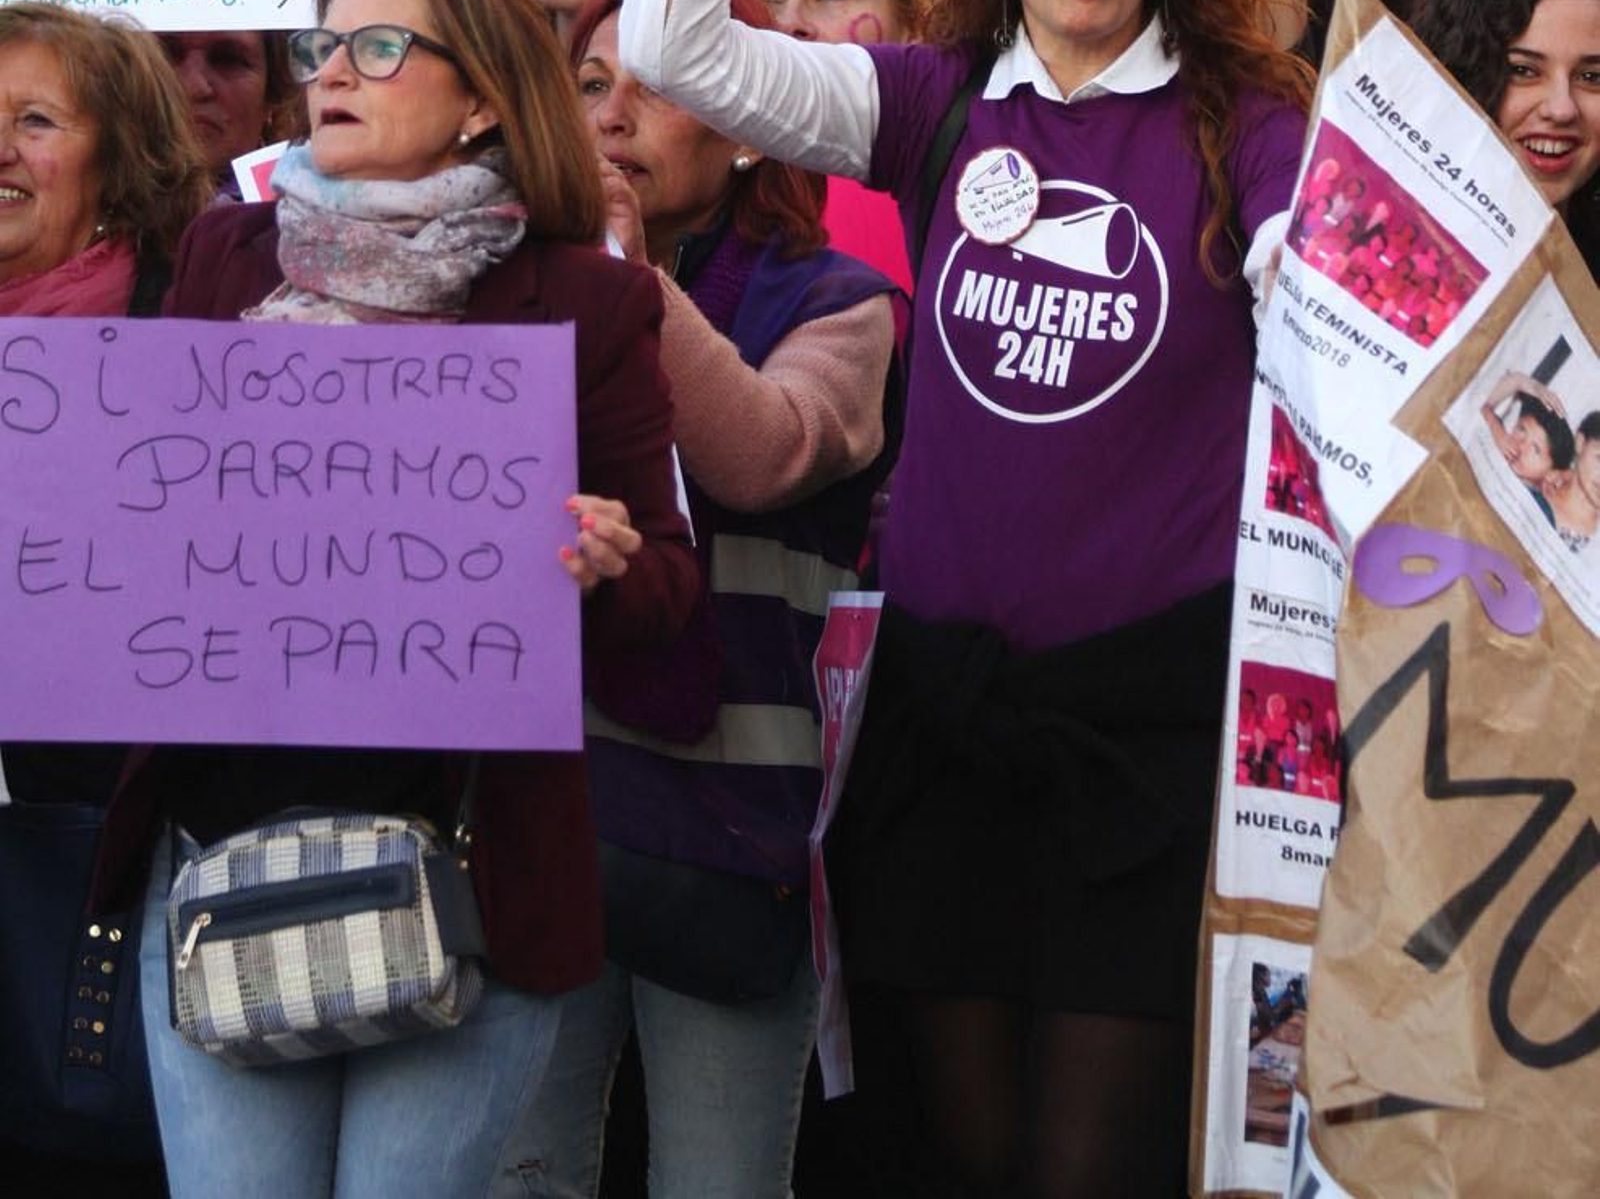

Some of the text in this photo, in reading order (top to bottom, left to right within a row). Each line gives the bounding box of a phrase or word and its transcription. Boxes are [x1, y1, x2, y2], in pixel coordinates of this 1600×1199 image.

[1354, 73, 1433, 154] Mujeres
[1432, 151, 1463, 182] 24
[1462, 176, 1518, 241] horas
[952, 268, 1139, 342] MUJERES
[1303, 296, 1409, 377] FEMINISTA
[994, 330, 1075, 388] 24H
[116, 434, 542, 512] PARAMOS
[17, 527, 503, 596] EL MUNDO
[1239, 521, 1262, 543] EL
[1250, 592, 1332, 629] Mujeres
[127, 616, 526, 689] SE PARA
[1235, 810, 1323, 839] HUELGA
[1281, 845, 1333, 868] 8mar
